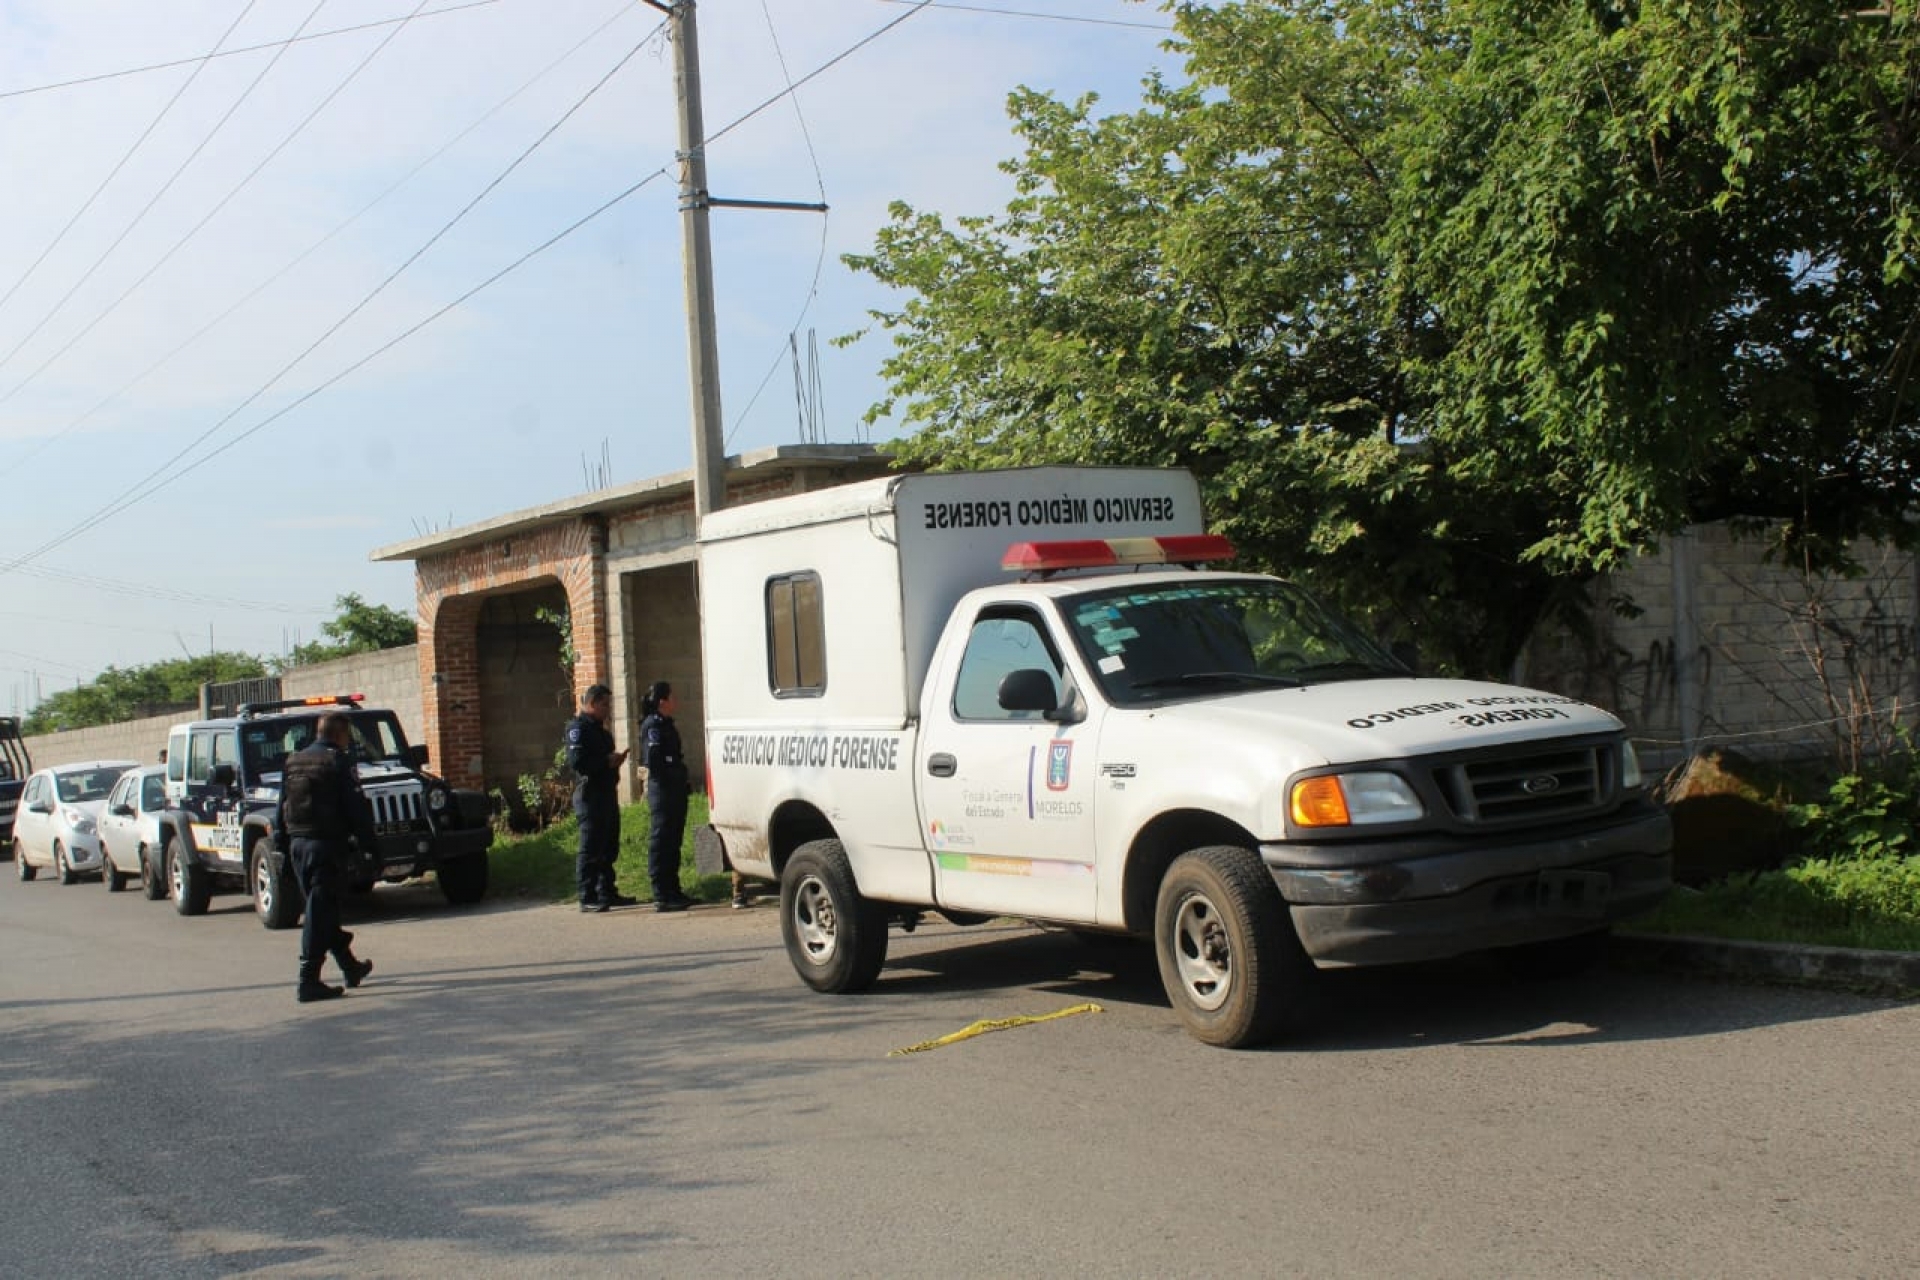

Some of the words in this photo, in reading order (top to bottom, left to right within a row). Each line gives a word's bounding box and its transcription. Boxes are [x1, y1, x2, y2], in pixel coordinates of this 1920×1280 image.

[722, 734, 776, 766] SERVICIO
[831, 736, 900, 771] FORENSE
[1035, 800, 1083, 815] MORELOS
